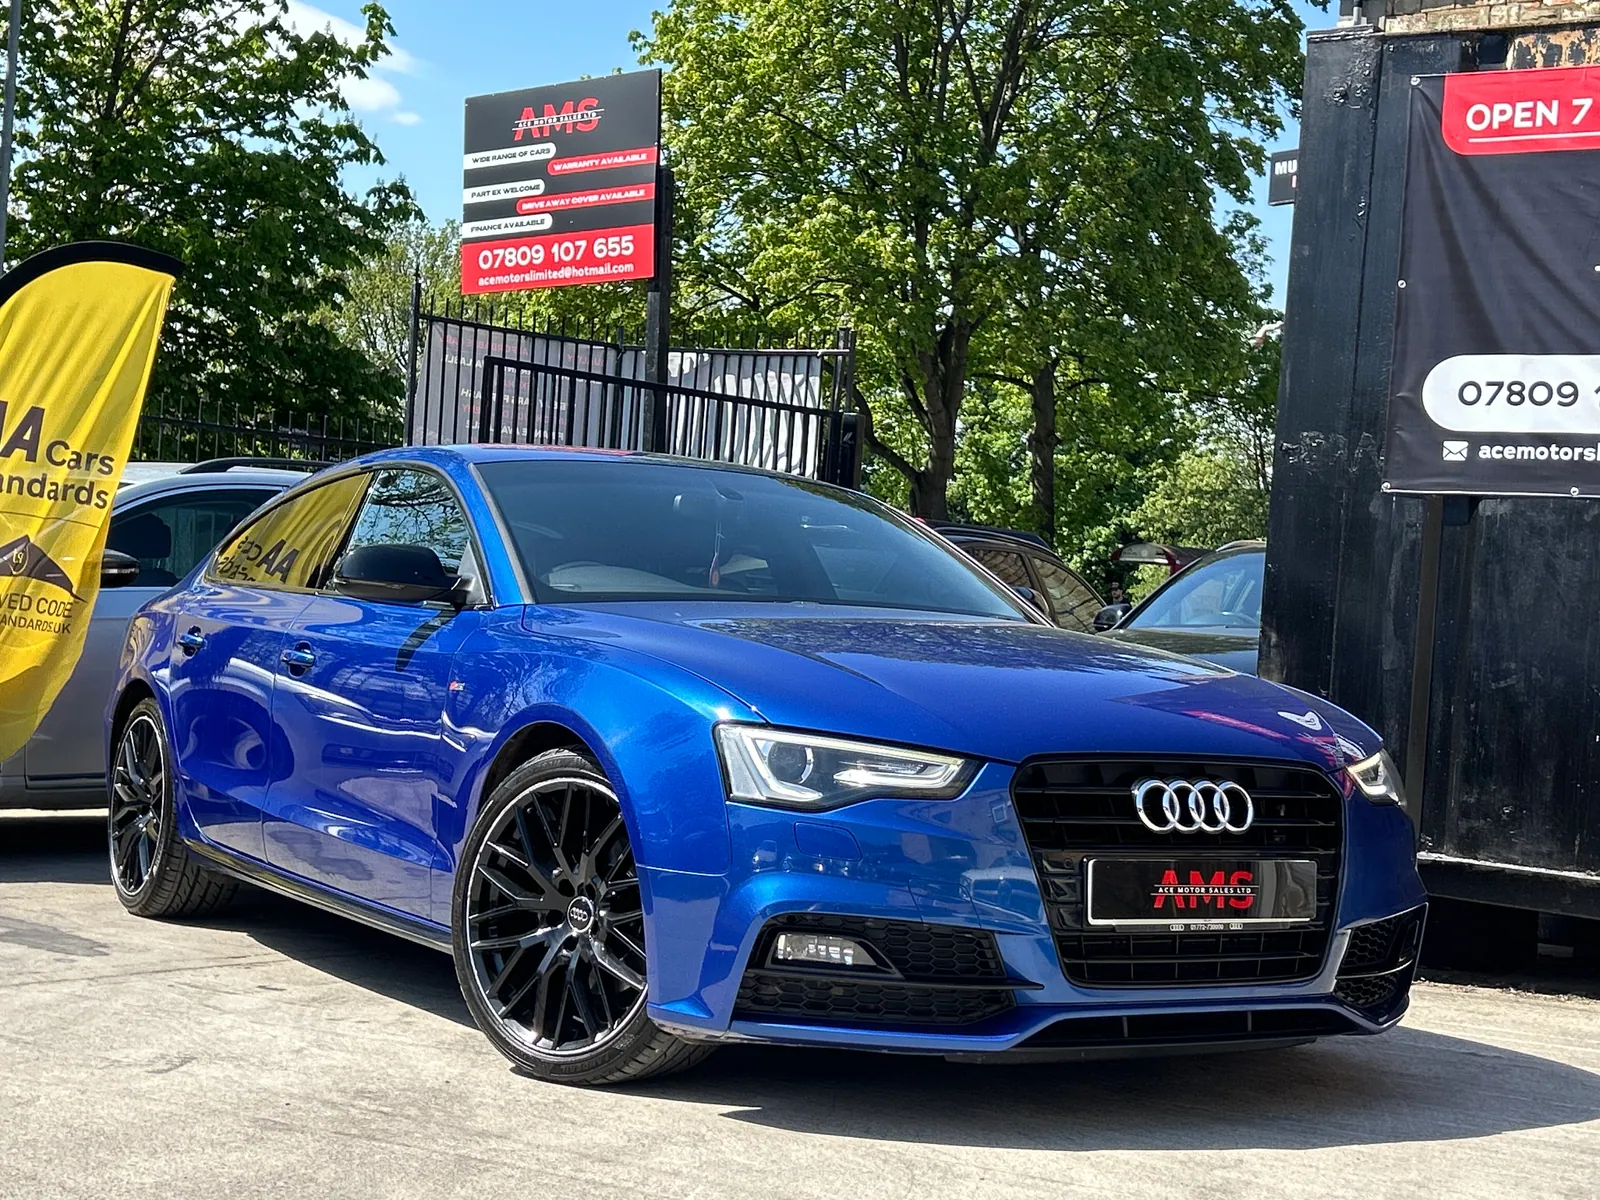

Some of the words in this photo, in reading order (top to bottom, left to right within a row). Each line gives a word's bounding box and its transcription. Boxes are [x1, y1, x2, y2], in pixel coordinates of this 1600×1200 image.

[513, 97, 599, 141] AMS
[518, 120, 531, 129] ACE
[533, 117, 558, 127] MOTOR
[559, 114, 582, 123] SALES
[582, 111, 597, 120] LTD
[1466, 99, 1559, 132] OPEN
[1571, 97, 1593, 125] 7
[472, 155, 491, 164] WIDE
[491, 151, 517, 162] RANGE
[518, 150, 529, 159] OF
[529, 147, 551, 157] CARS
[553, 159, 600, 172] WARRANTY
[600, 153, 648, 165] AVAILABLE
[471, 190, 491, 199] PART
[492, 188, 502, 197] EX
[502, 183, 541, 195] WELCOME
[571, 195, 600, 205] COVER
[599, 189, 646, 201] AVAILABLE
[470, 222, 502, 233] FINANCE
[503, 218, 546, 229] AVAILABLE
[478, 243, 545, 270] 07809
[550, 239, 587, 263] 107
[593, 234, 635, 259] 655
[478, 262, 634, 287] acemotorslimited@hotmail.com
[1458, 380, 1579, 407] 07809
[46, 439, 115, 476] Cars
[36, 597, 73, 619] CODE
[1153, 869, 1254, 909] AMS
